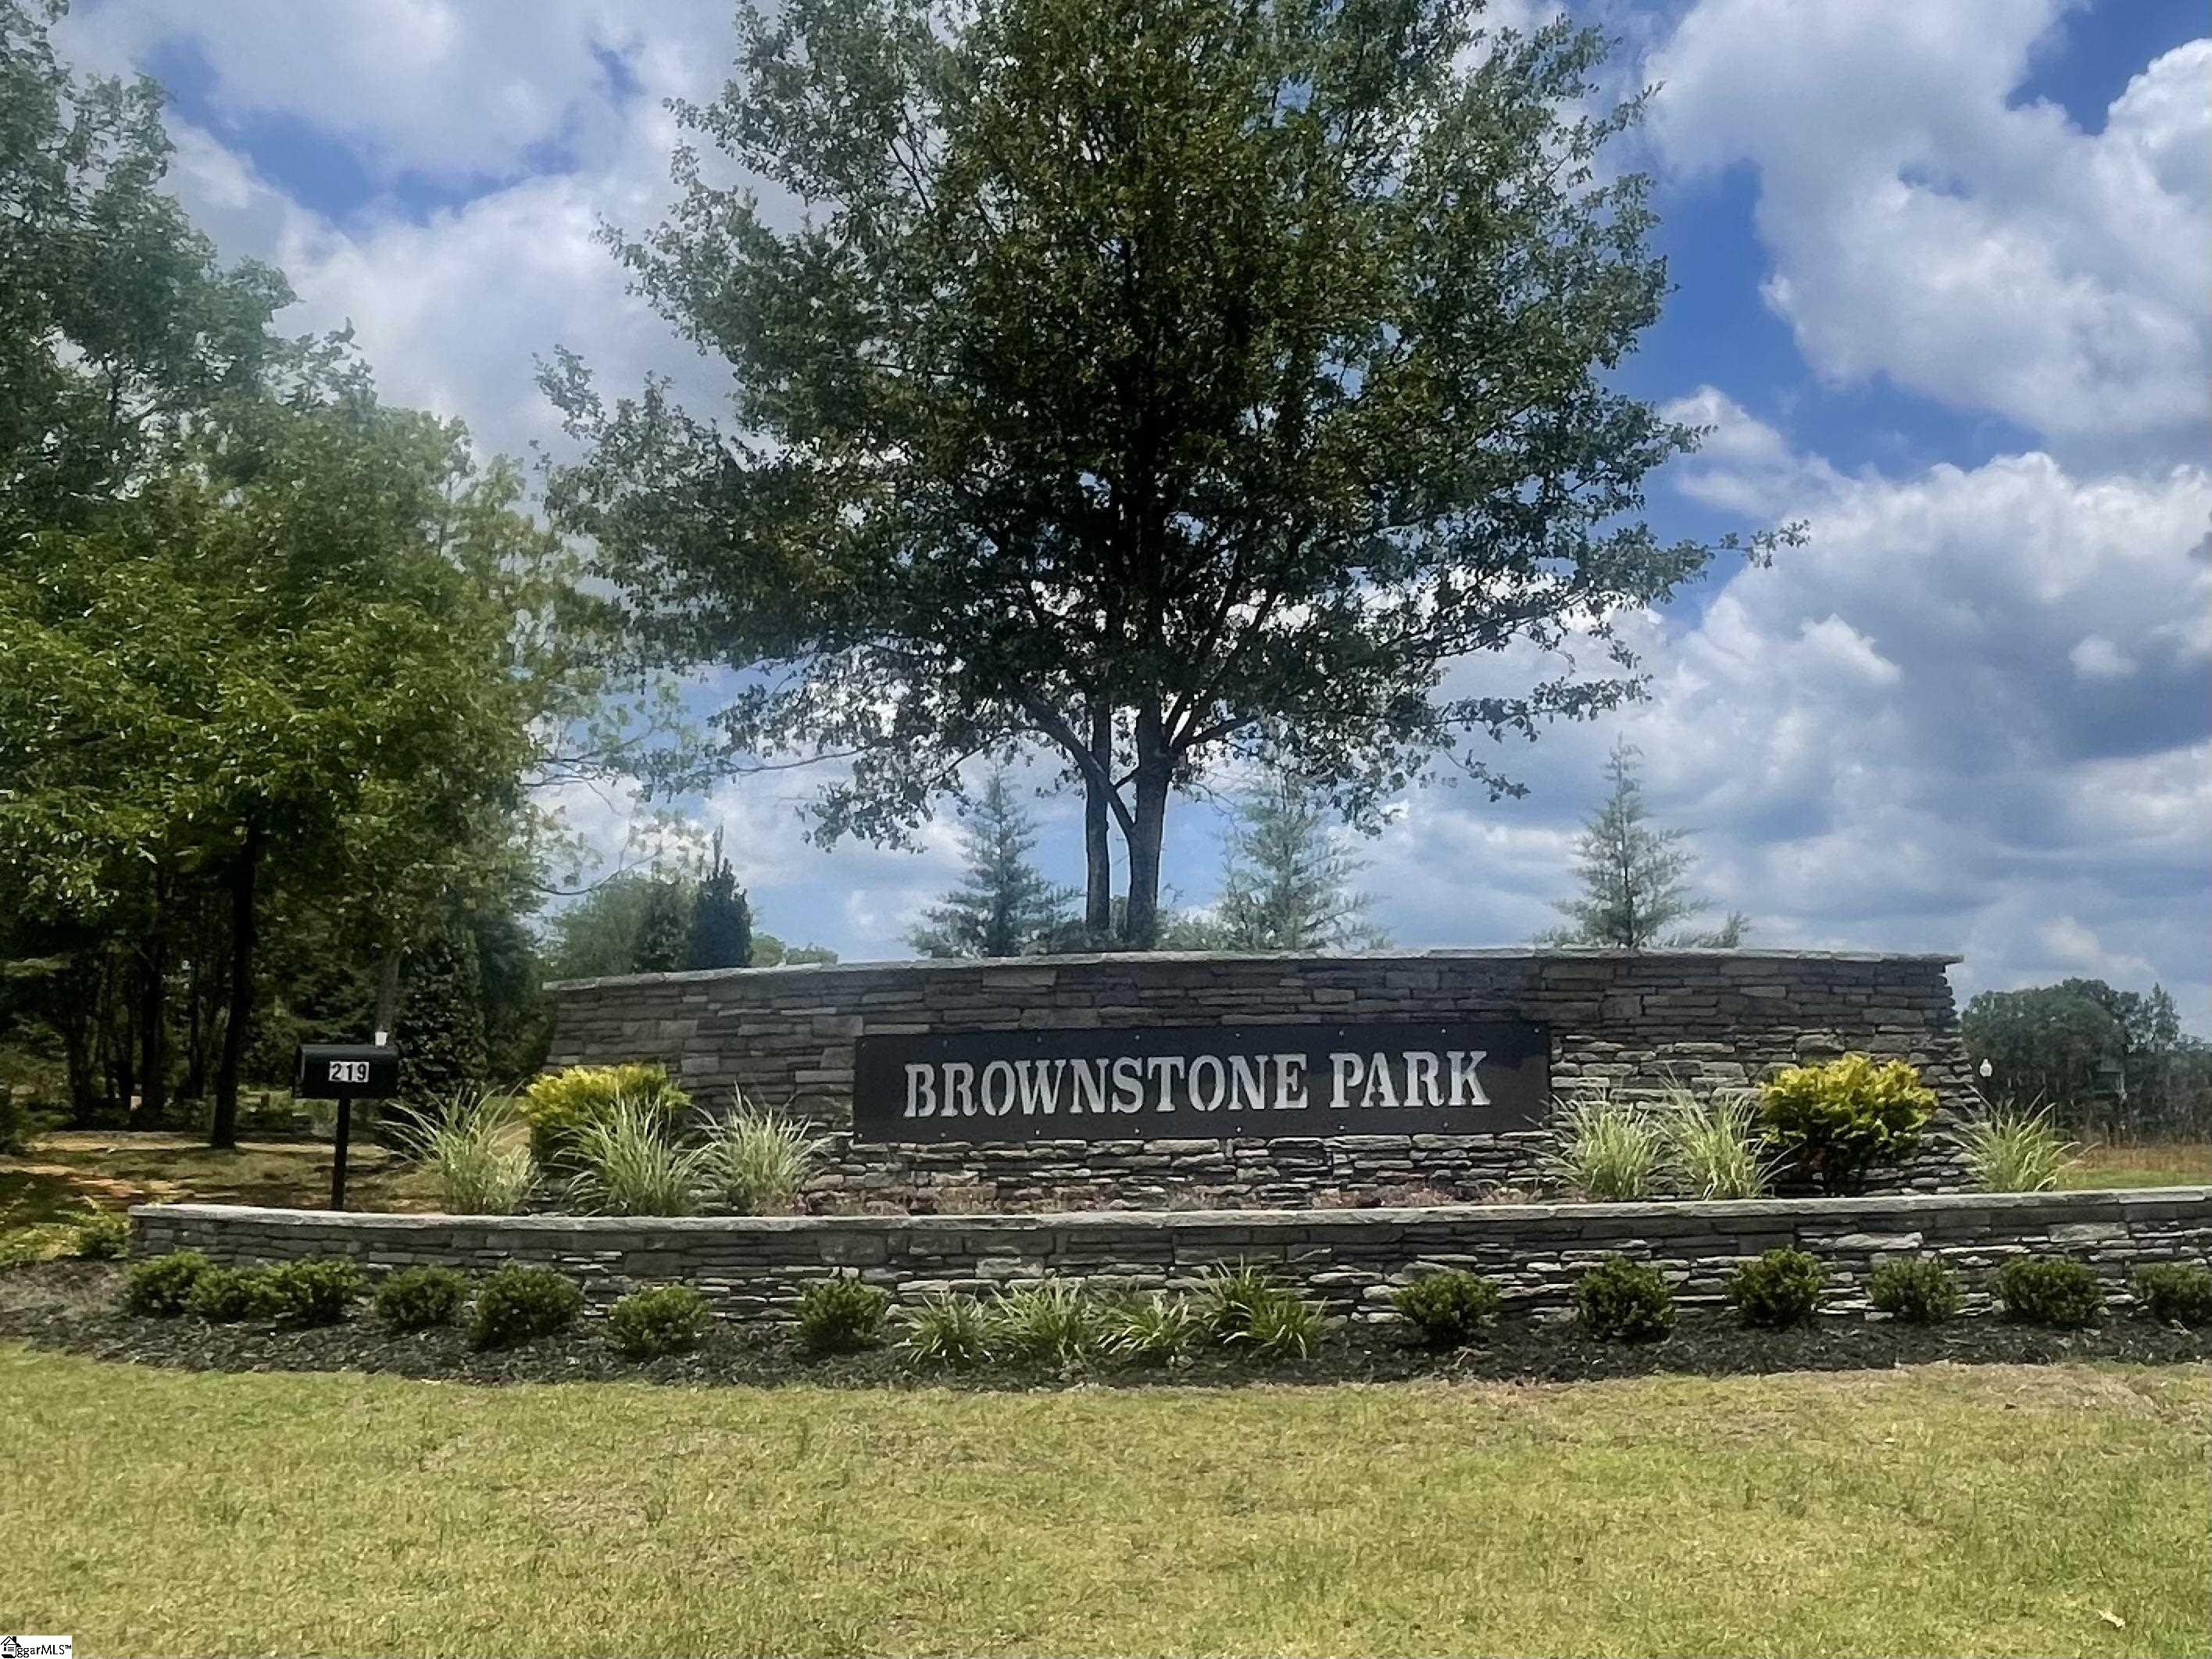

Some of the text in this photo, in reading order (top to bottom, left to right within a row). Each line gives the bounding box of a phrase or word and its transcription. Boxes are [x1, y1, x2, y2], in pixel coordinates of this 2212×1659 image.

[330, 1063, 367, 1082] 219
[902, 1049, 1492, 1118] BROWNSTONE PARK
